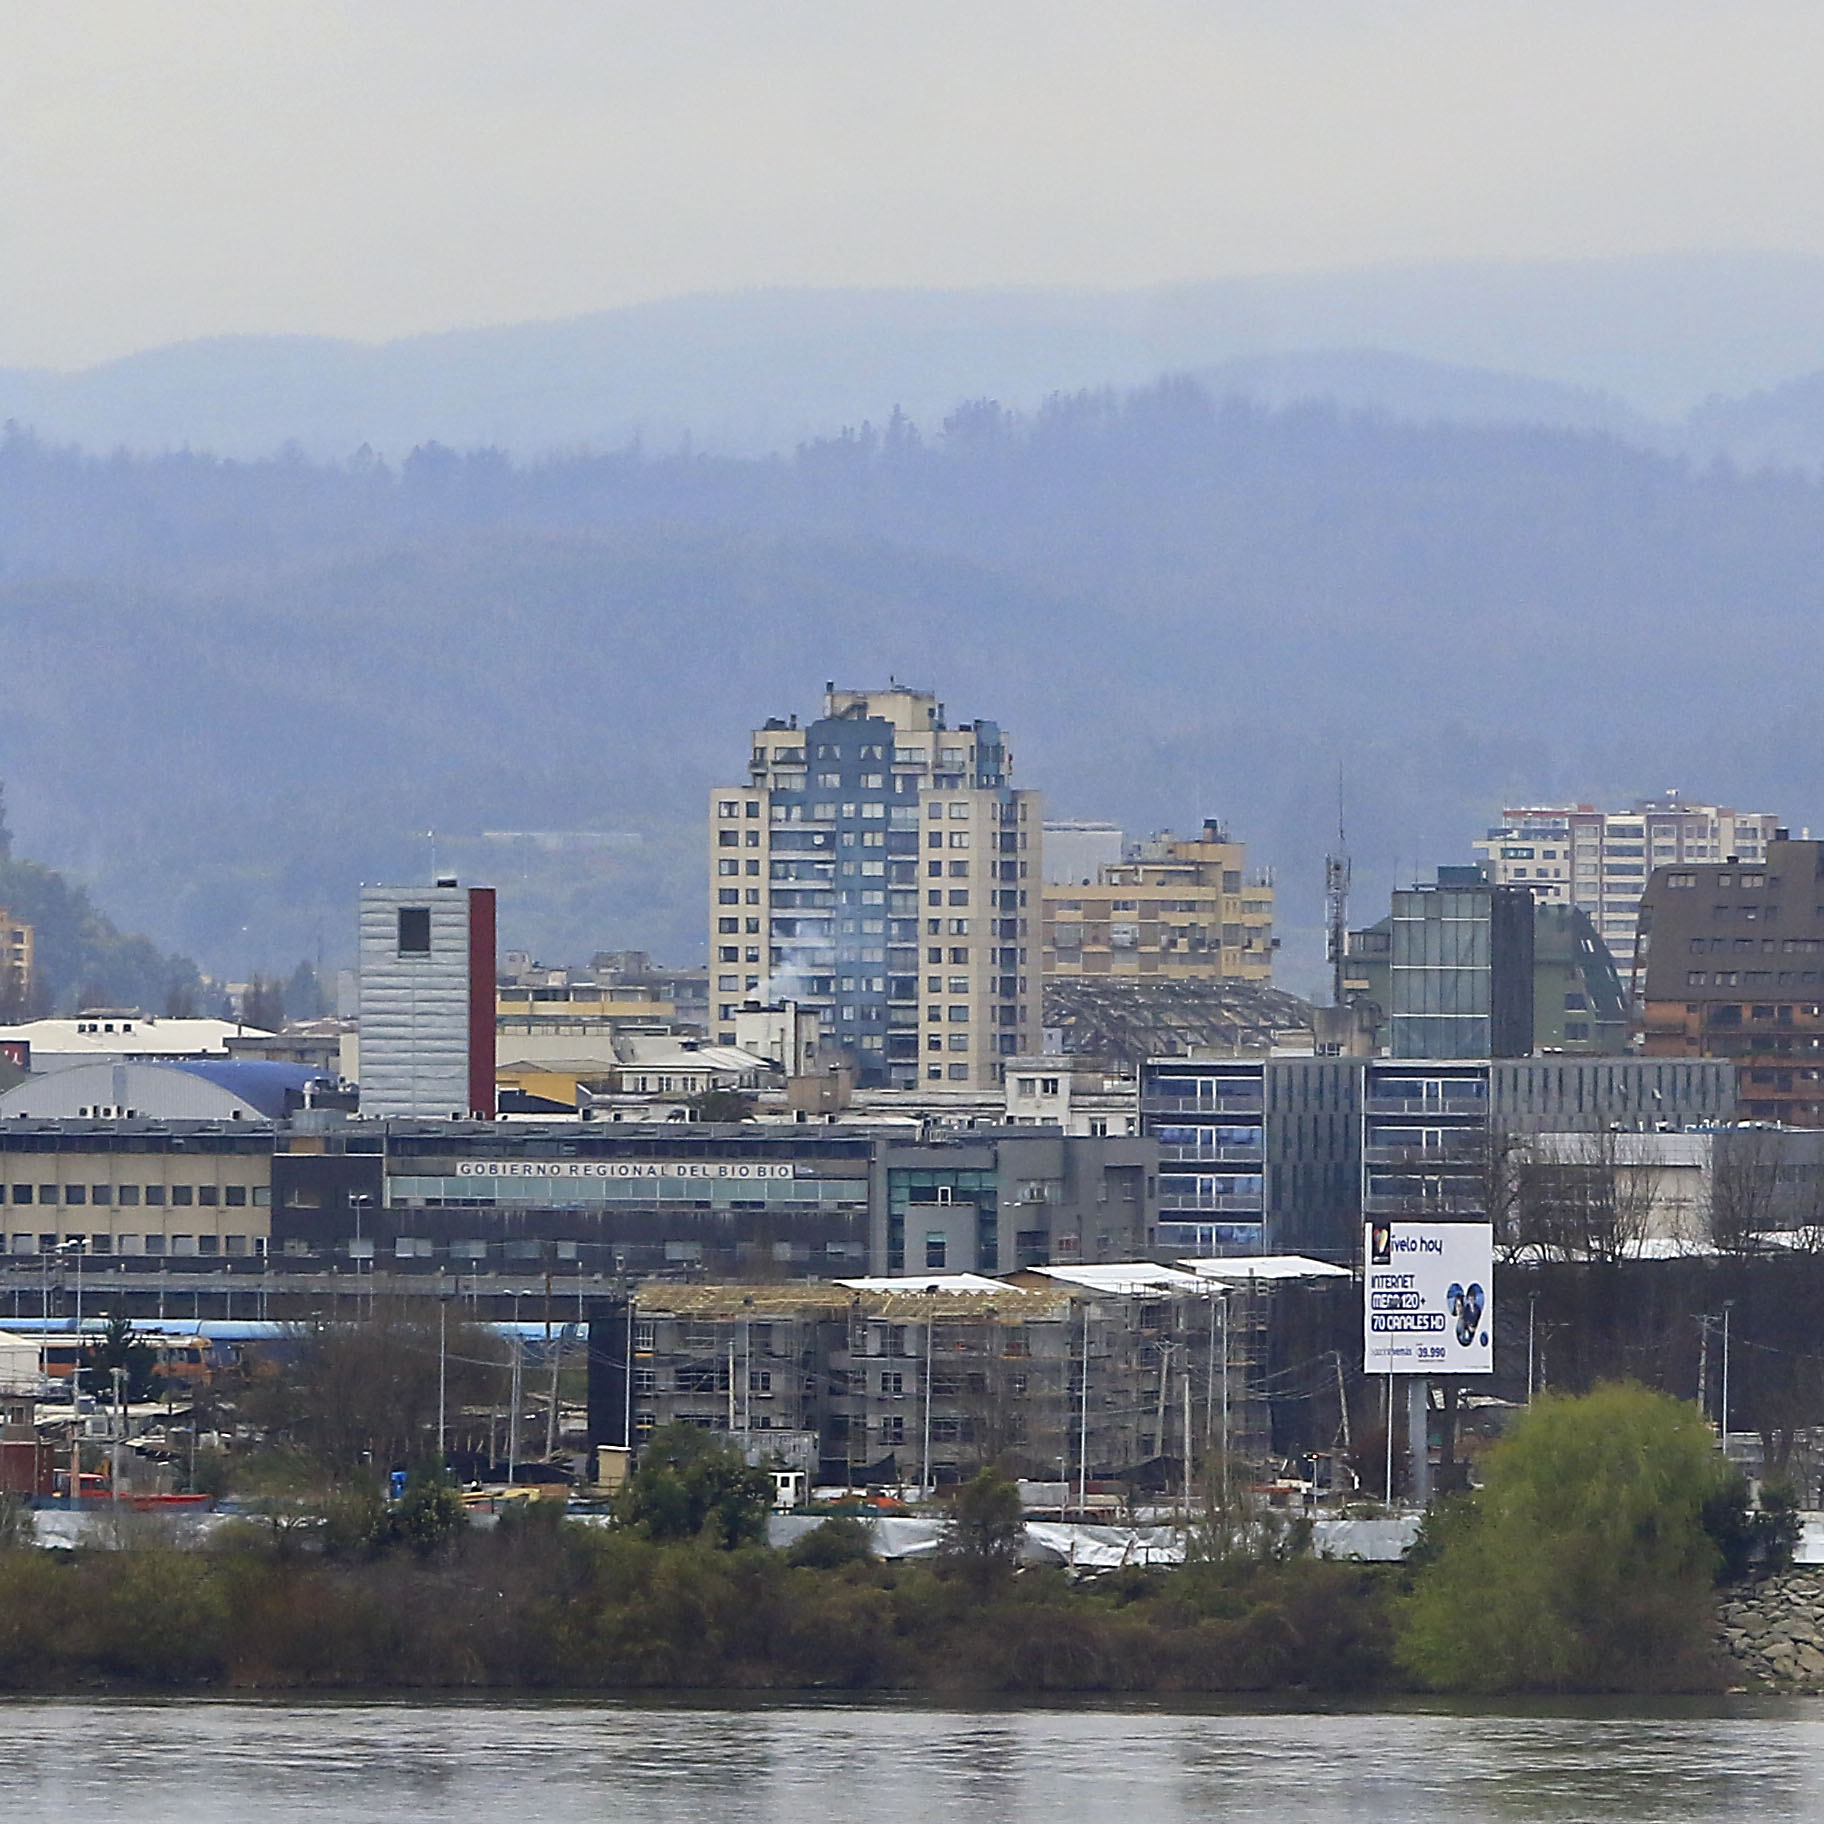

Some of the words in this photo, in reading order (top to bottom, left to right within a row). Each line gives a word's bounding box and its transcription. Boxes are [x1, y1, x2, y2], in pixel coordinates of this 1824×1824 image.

[460, 1163, 561, 1176] GOBIERNO
[569, 1164, 668, 1177] REGIONAL
[677, 1165, 711, 1177] DEL
[718, 1165, 750, 1178] BIO
[757, 1165, 789, 1178] BIO
[1420, 1235, 1443, 1256] hoy
[1371, 1274, 1415, 1289] INTERNET
[1401, 1293, 1419, 1308] 120
[1372, 1315, 1386, 1331] 70
[1386, 1315, 1430, 1331] CANALES
[1430, 1315, 1444, 1330] HD
